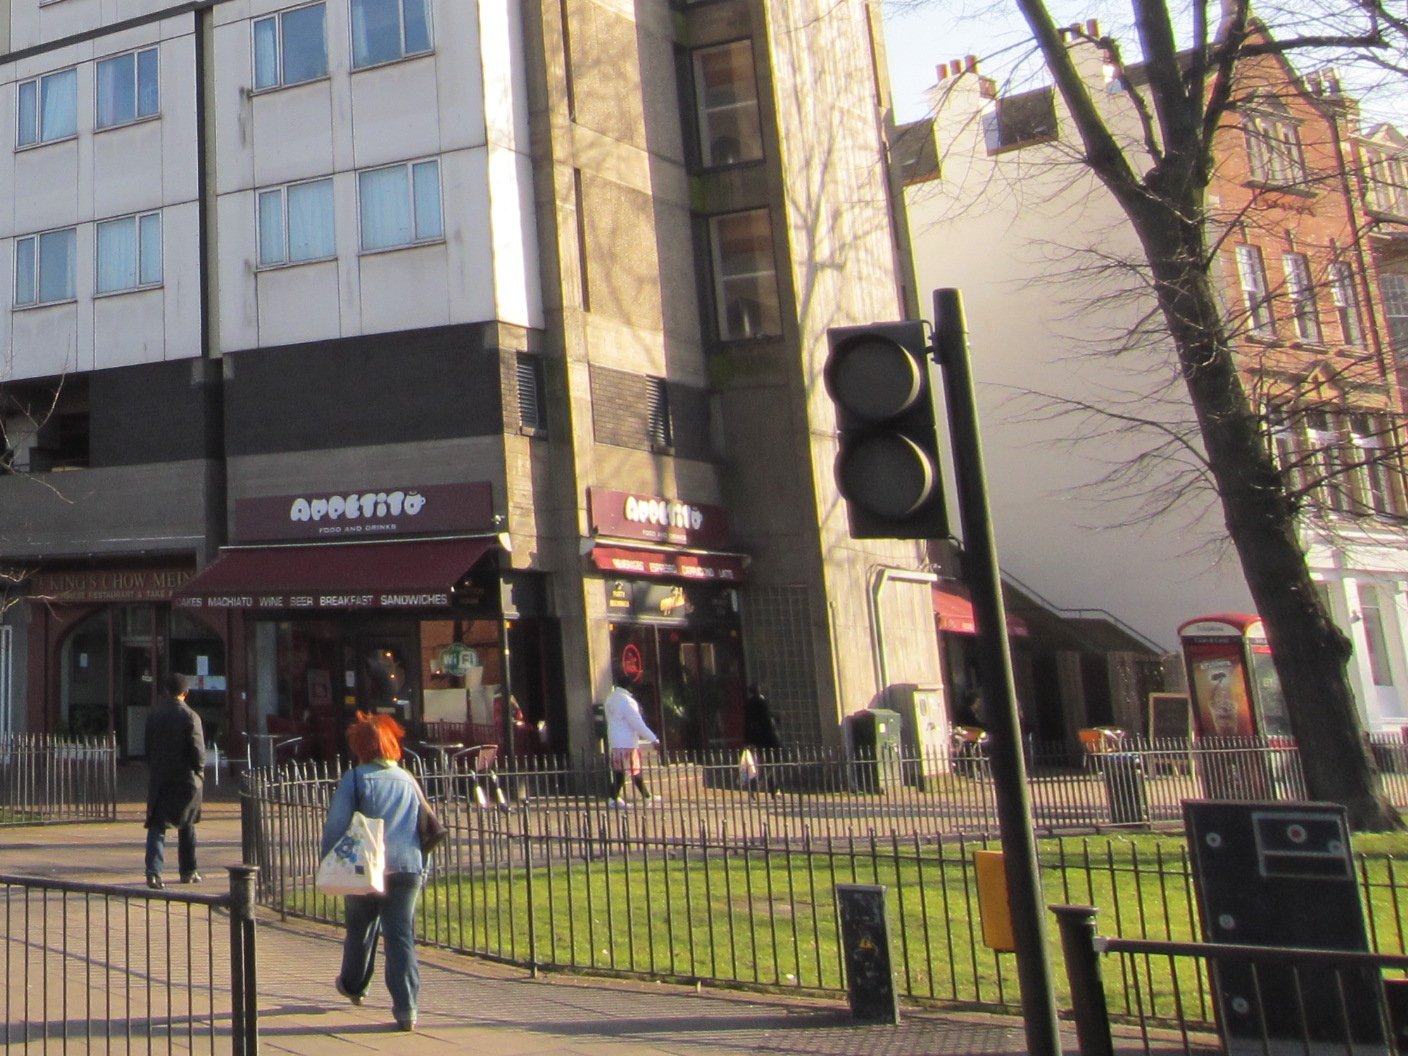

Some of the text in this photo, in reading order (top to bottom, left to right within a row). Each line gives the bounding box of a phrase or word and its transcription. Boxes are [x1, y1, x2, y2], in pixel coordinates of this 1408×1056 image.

[319, 526, 342, 534] FOOD
[365, 524, 397, 532] DRINKS
[102, 573, 146, 590] CHOW
[153, 570, 193, 588] MEIN
[259, 596, 283, 607] WINE
[290, 596, 313, 607] BEER
[319, 595, 373, 606] BREAKFAST
[380, 594, 448, 605] SANDWICHES
